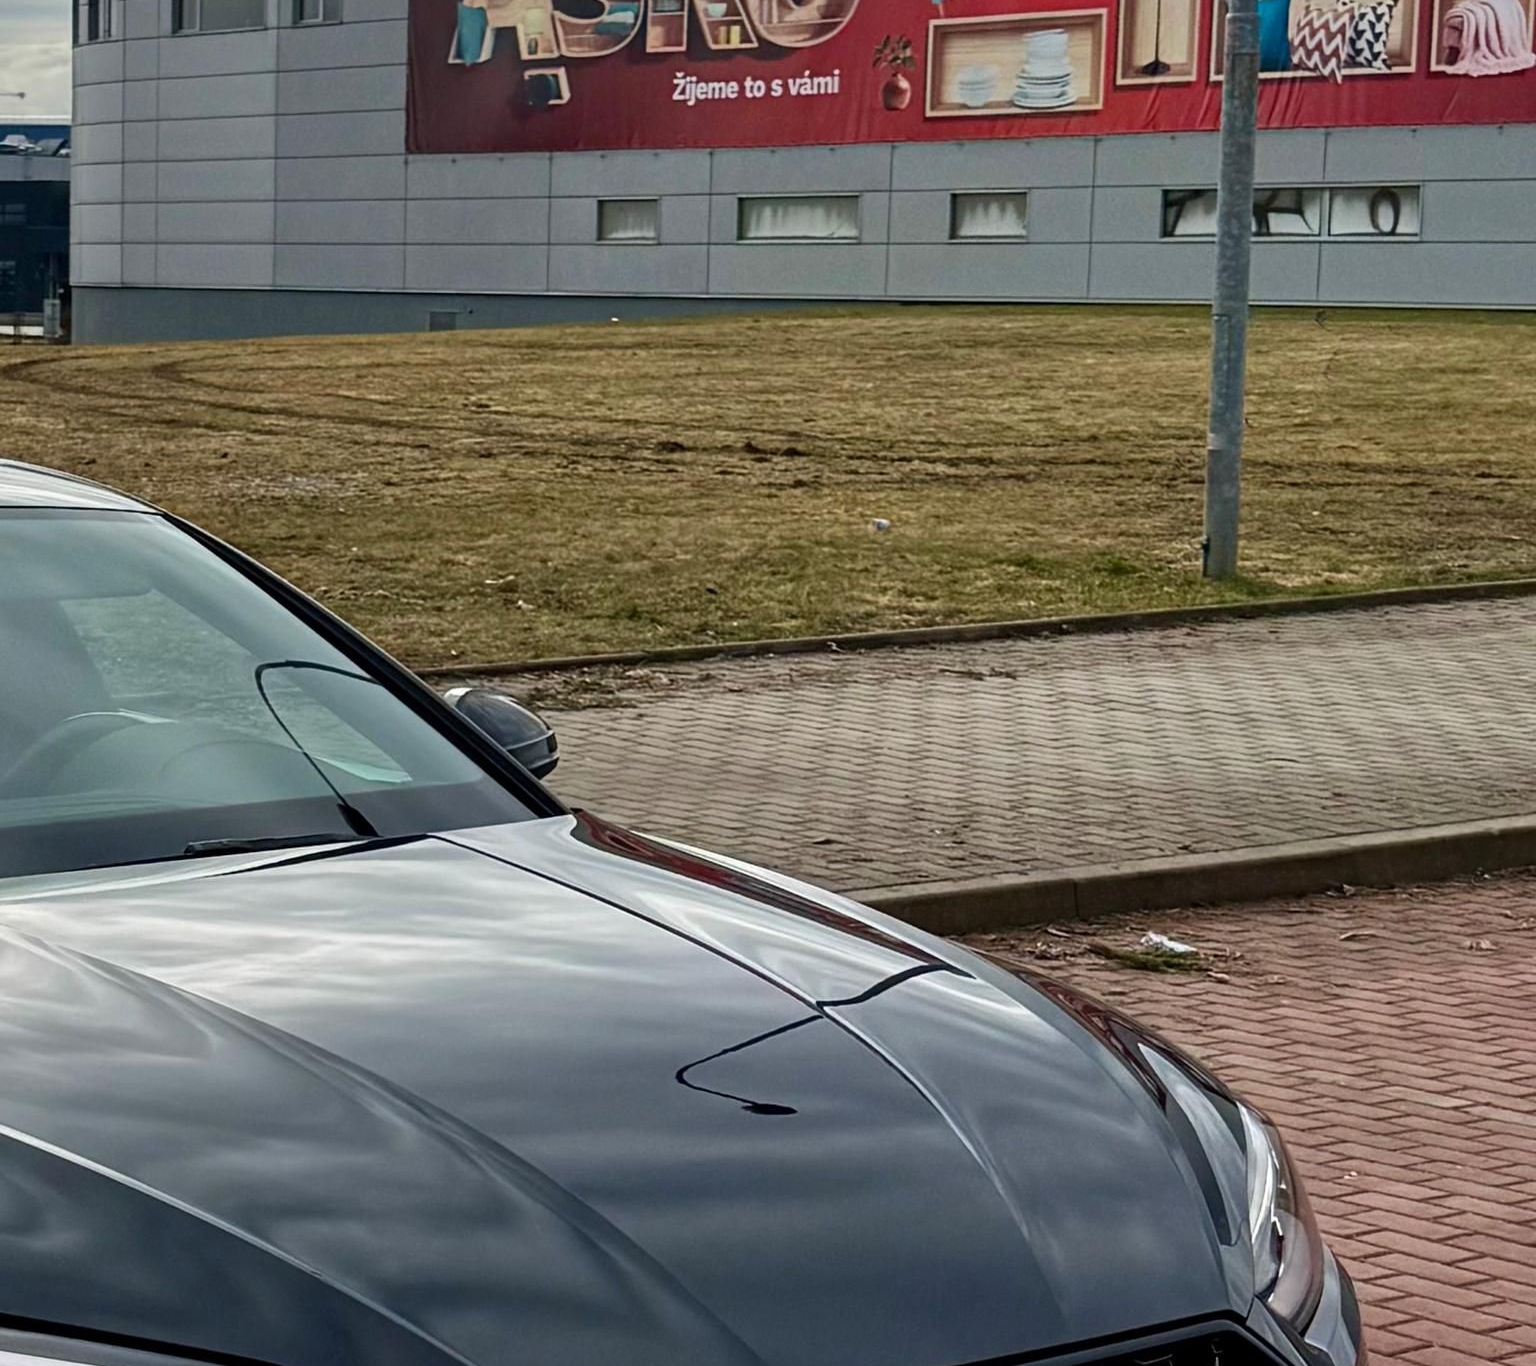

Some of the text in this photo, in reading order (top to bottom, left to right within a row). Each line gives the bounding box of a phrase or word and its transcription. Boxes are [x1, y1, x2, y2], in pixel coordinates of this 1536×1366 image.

[672, 69, 840, 107] Žijeme to s vámi
